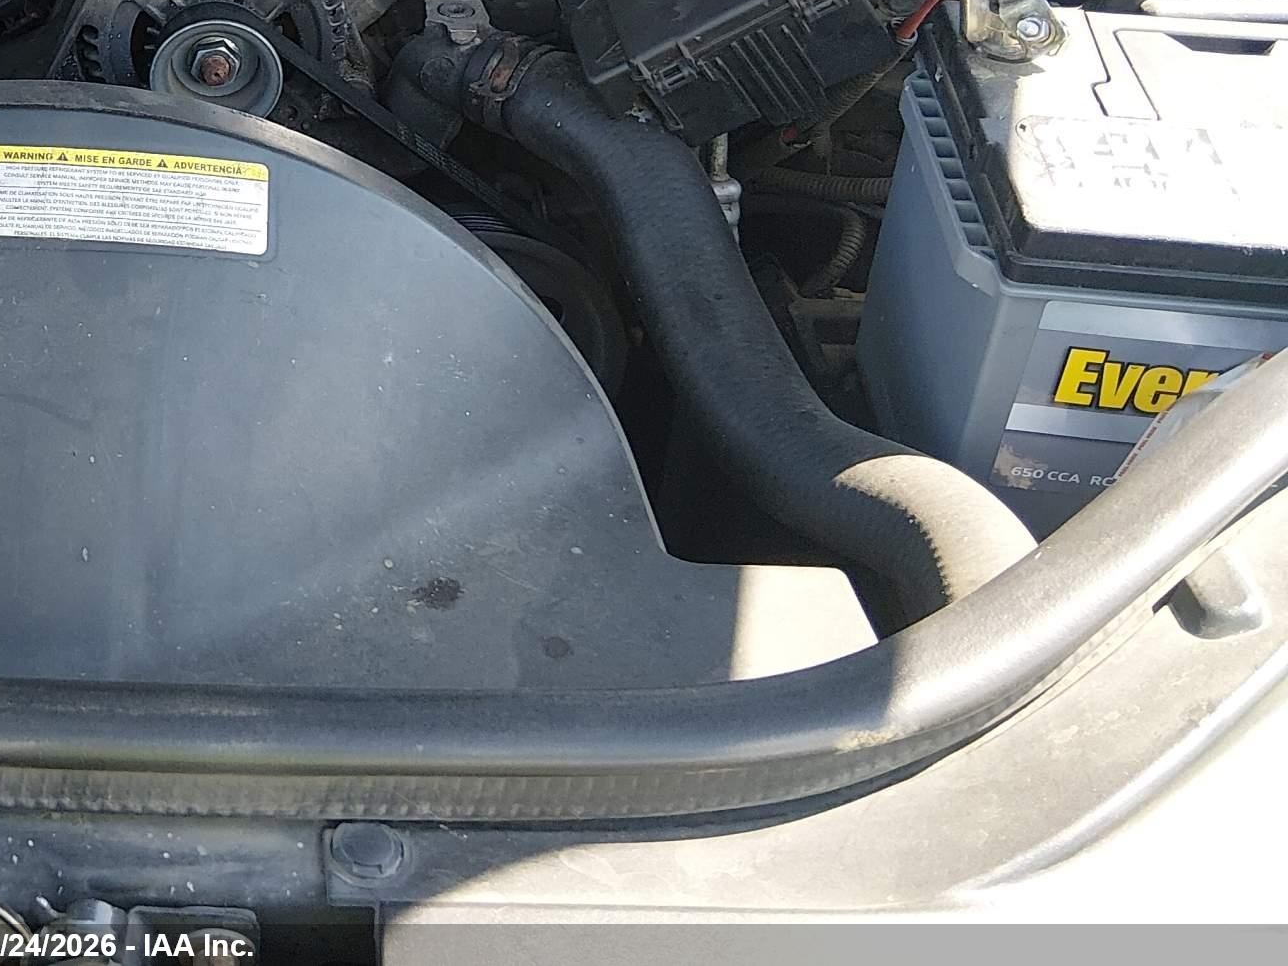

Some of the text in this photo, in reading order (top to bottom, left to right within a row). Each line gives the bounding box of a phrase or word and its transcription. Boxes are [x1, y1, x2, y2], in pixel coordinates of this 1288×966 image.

[3, 152, 53, 160] WARNING
[75, 154, 99, 163] MISE
[119, 157, 152, 166] GARDE
[1010, 465, 1044, 480] 650
[1047, 470, 1081, 485] CCA
